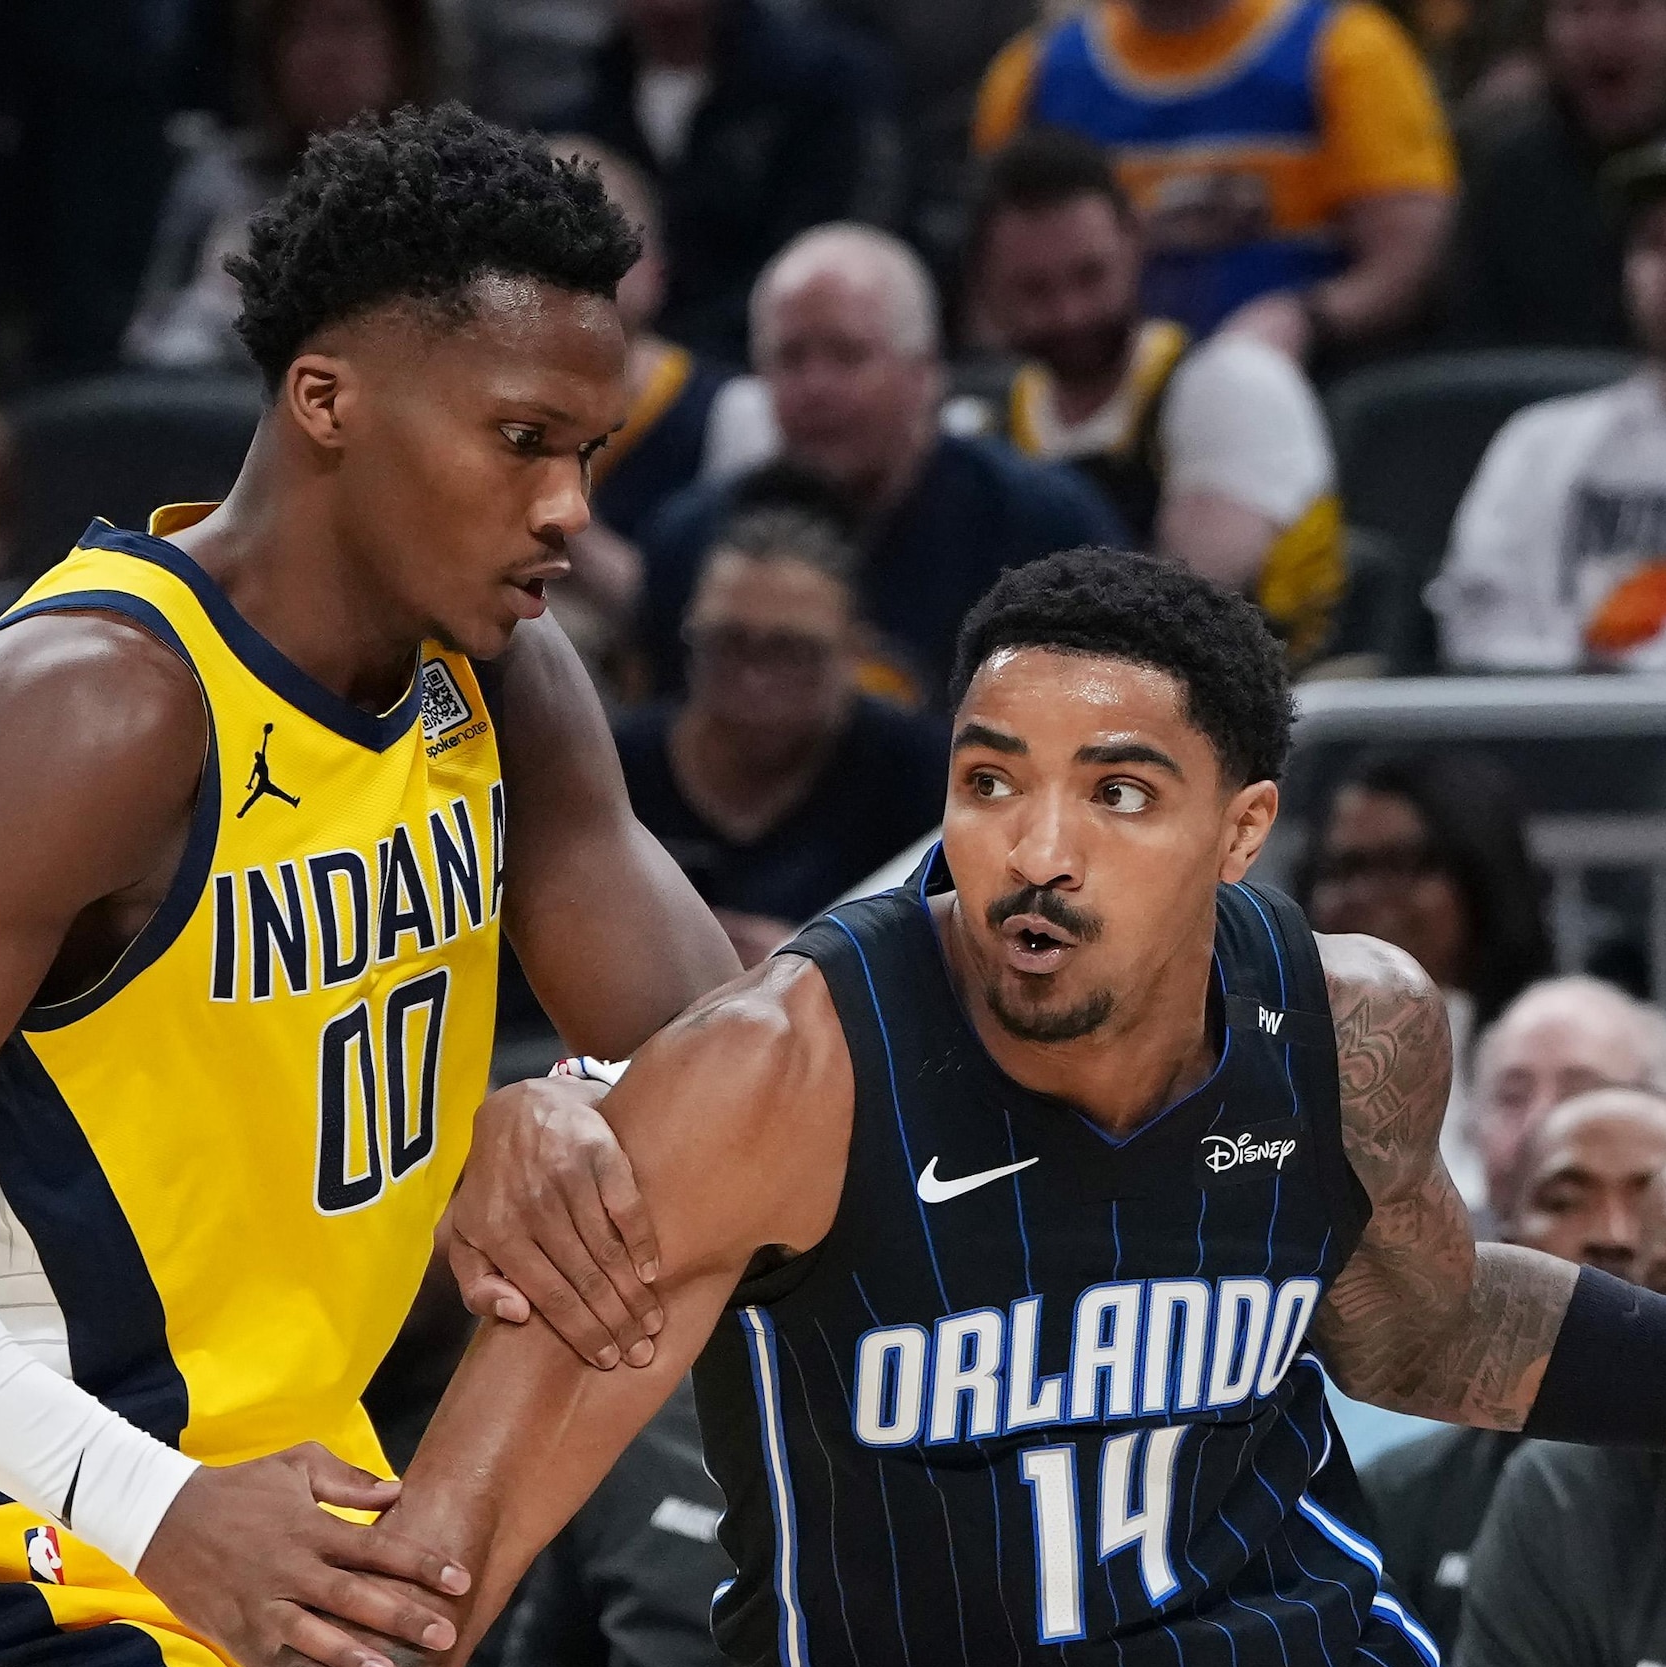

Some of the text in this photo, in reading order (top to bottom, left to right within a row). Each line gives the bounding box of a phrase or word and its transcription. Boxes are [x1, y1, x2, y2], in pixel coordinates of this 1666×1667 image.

[425, 720, 488, 760] spokenote
[1257, 1005, 1284, 1036] PW
[312, 965, 451, 1217] 00
[1201, 1132, 1296, 1174] Disney
[852, 1275, 1322, 1449] ORLANDO
[1018, 1425, 1195, 1645] 14
